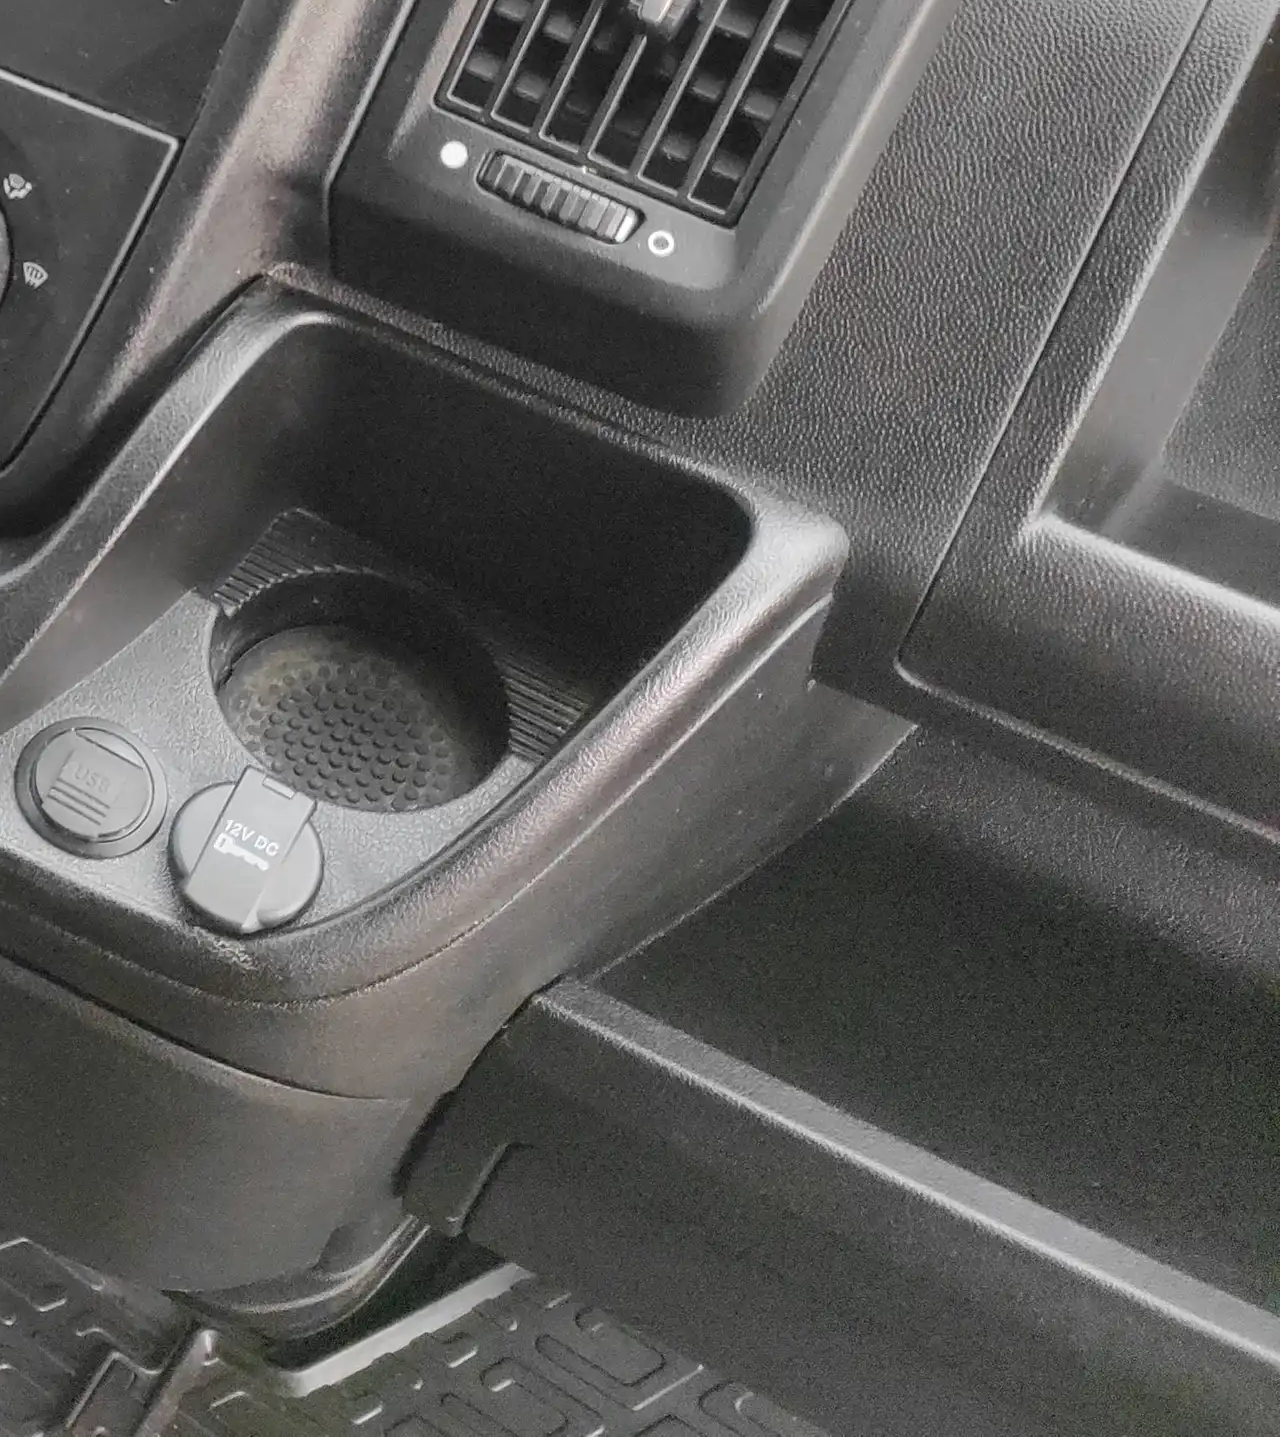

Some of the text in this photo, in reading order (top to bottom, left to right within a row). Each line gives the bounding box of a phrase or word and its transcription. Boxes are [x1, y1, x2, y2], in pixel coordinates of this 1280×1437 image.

[74, 763, 111, 794] USB
[225, 819, 280, 856] 12V DC
